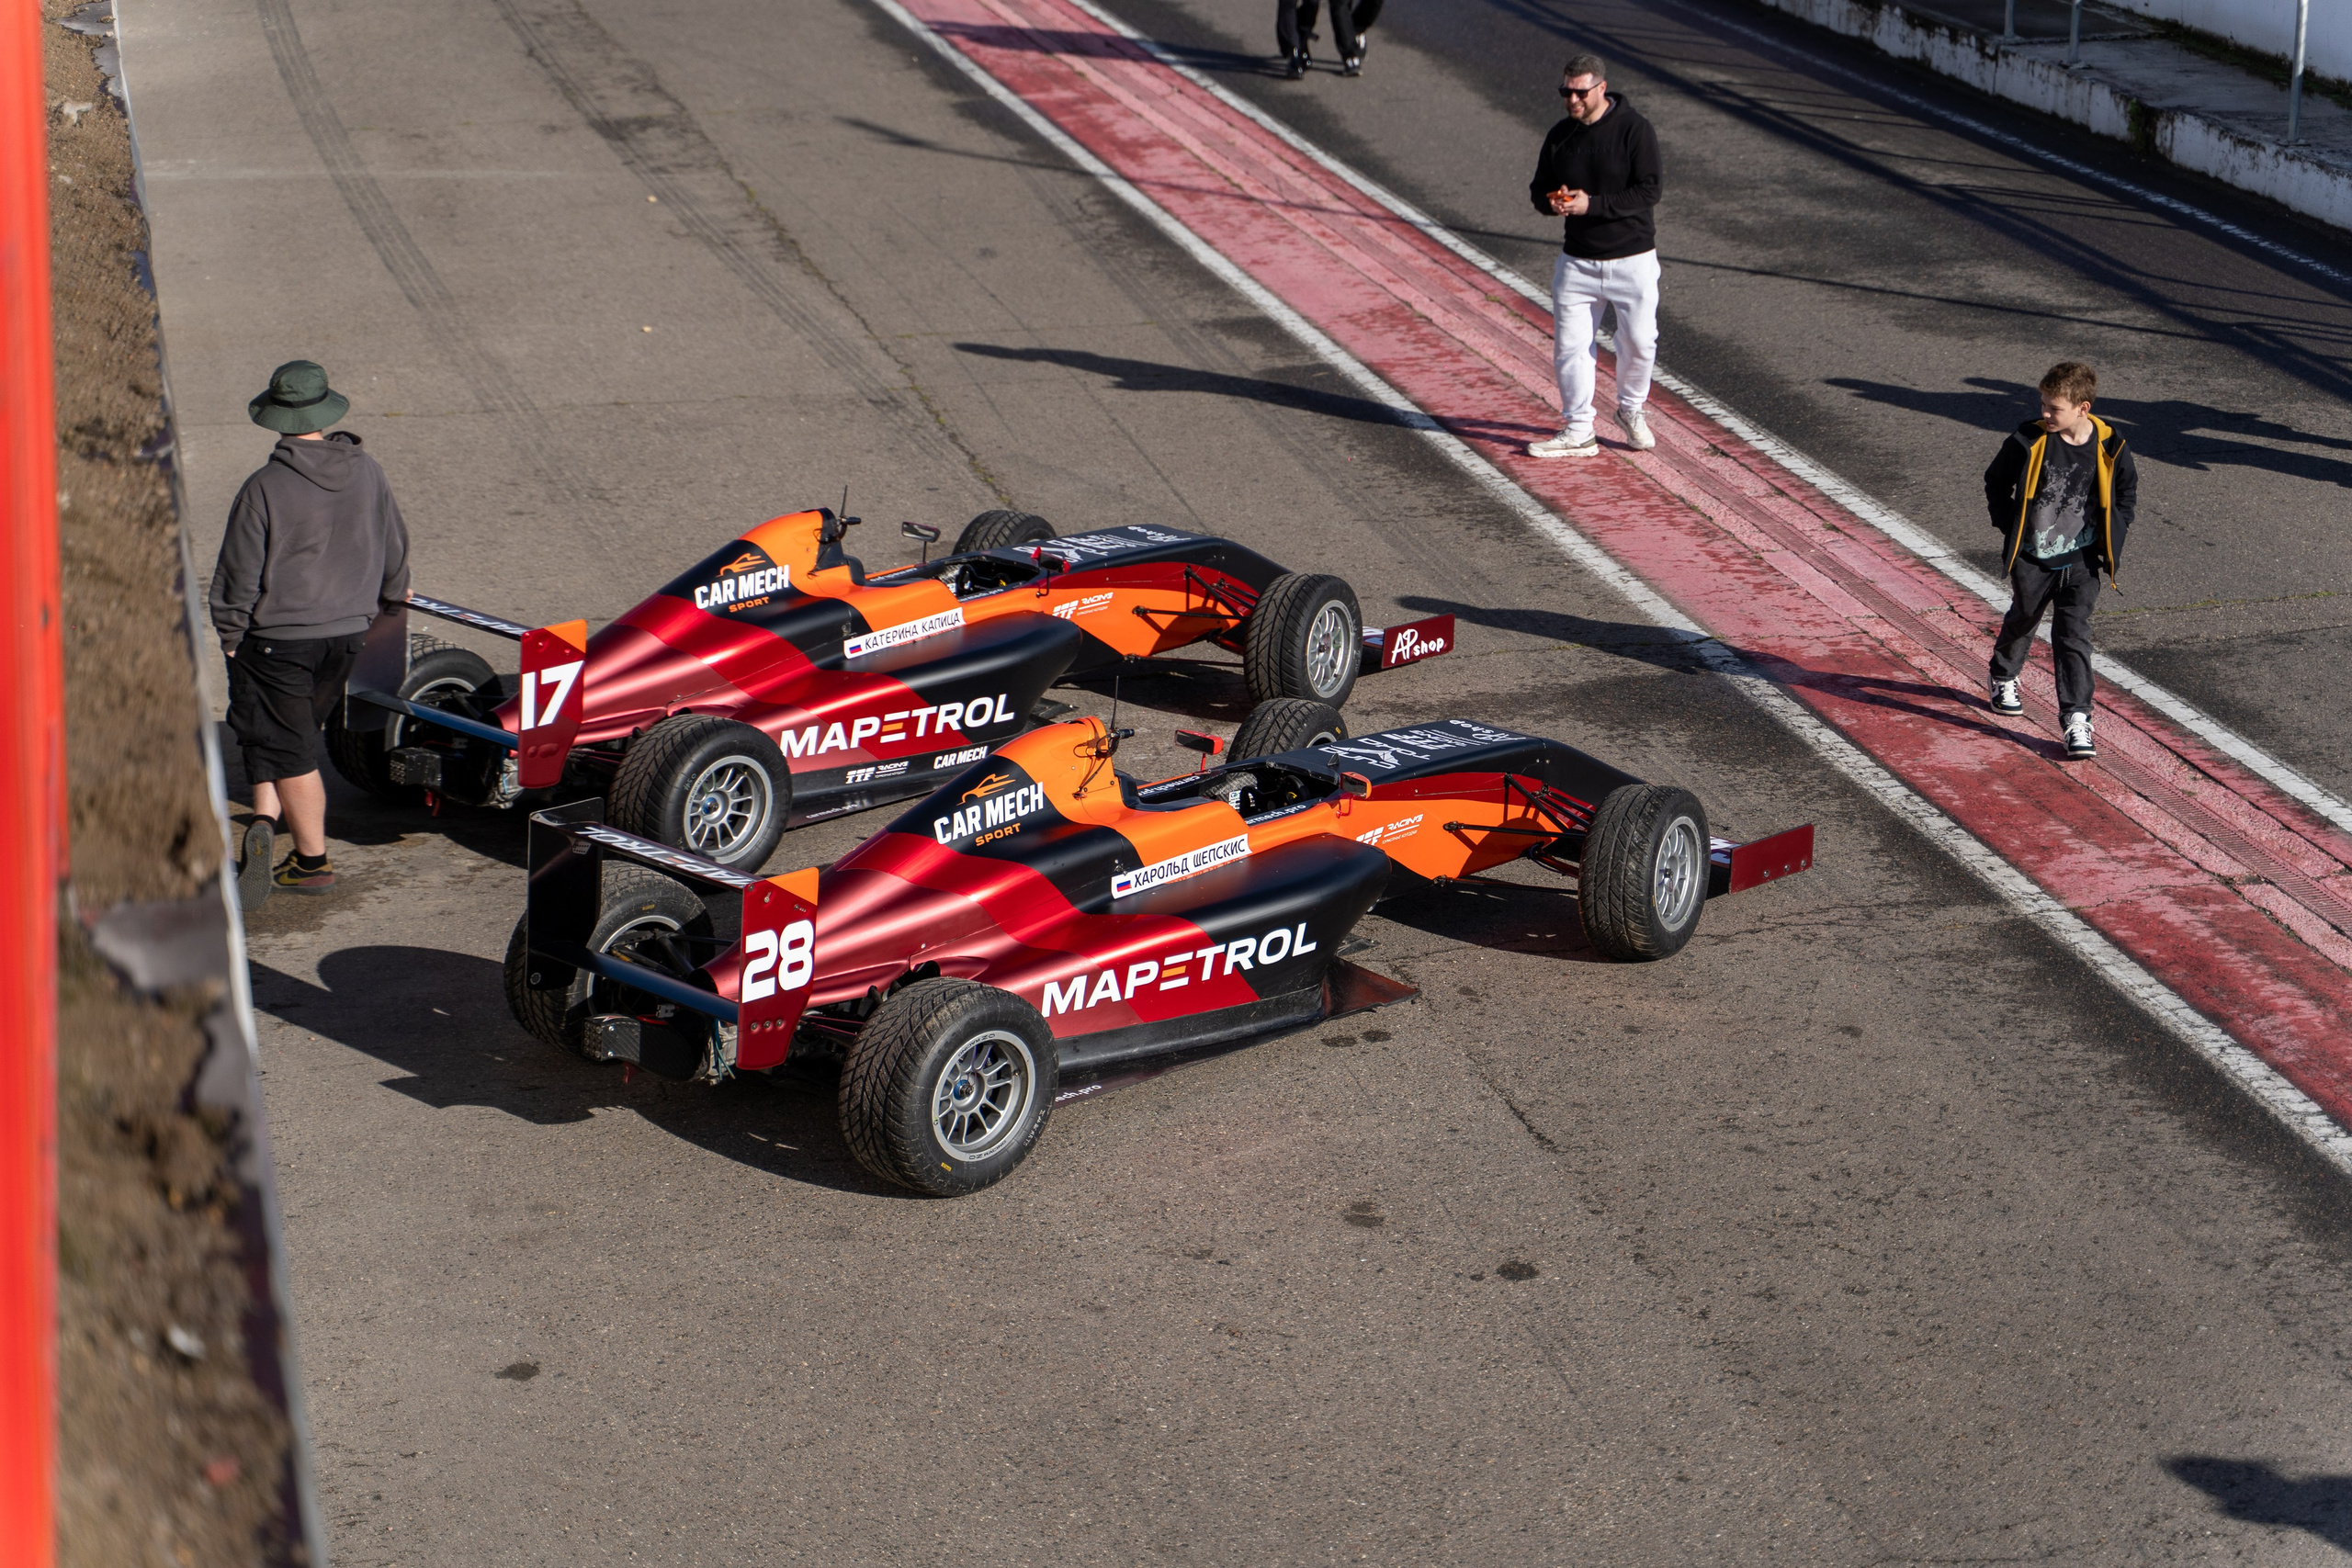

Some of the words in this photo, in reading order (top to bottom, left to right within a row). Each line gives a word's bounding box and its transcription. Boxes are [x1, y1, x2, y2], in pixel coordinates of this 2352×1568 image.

[695, 579, 735, 609] CAR
[738, 564, 789, 600] MECH
[729, 596, 770, 613] SPORT
[865, 626, 919, 650] КАТЕРИНА
[922, 612, 961, 633] КАПИЦА
[1412, 637, 1445, 658] shop
[521, 660, 584, 731] 17
[781, 694, 1015, 760] MAPETROL
[933, 752, 956, 770] CAR
[956, 746, 989, 764] MECH
[933, 805, 982, 845] CAR
[985, 782, 1044, 829] MECH
[975, 822, 1022, 846] SPORT
[1387, 814, 1424, 830] RACING
[1135, 858, 1191, 888] ХАРОЛЬД
[1193, 838, 1246, 868] ШЕПСКИС
[741, 919, 815, 1004] 28
[1042, 922, 1317, 1019] MAPETROL
